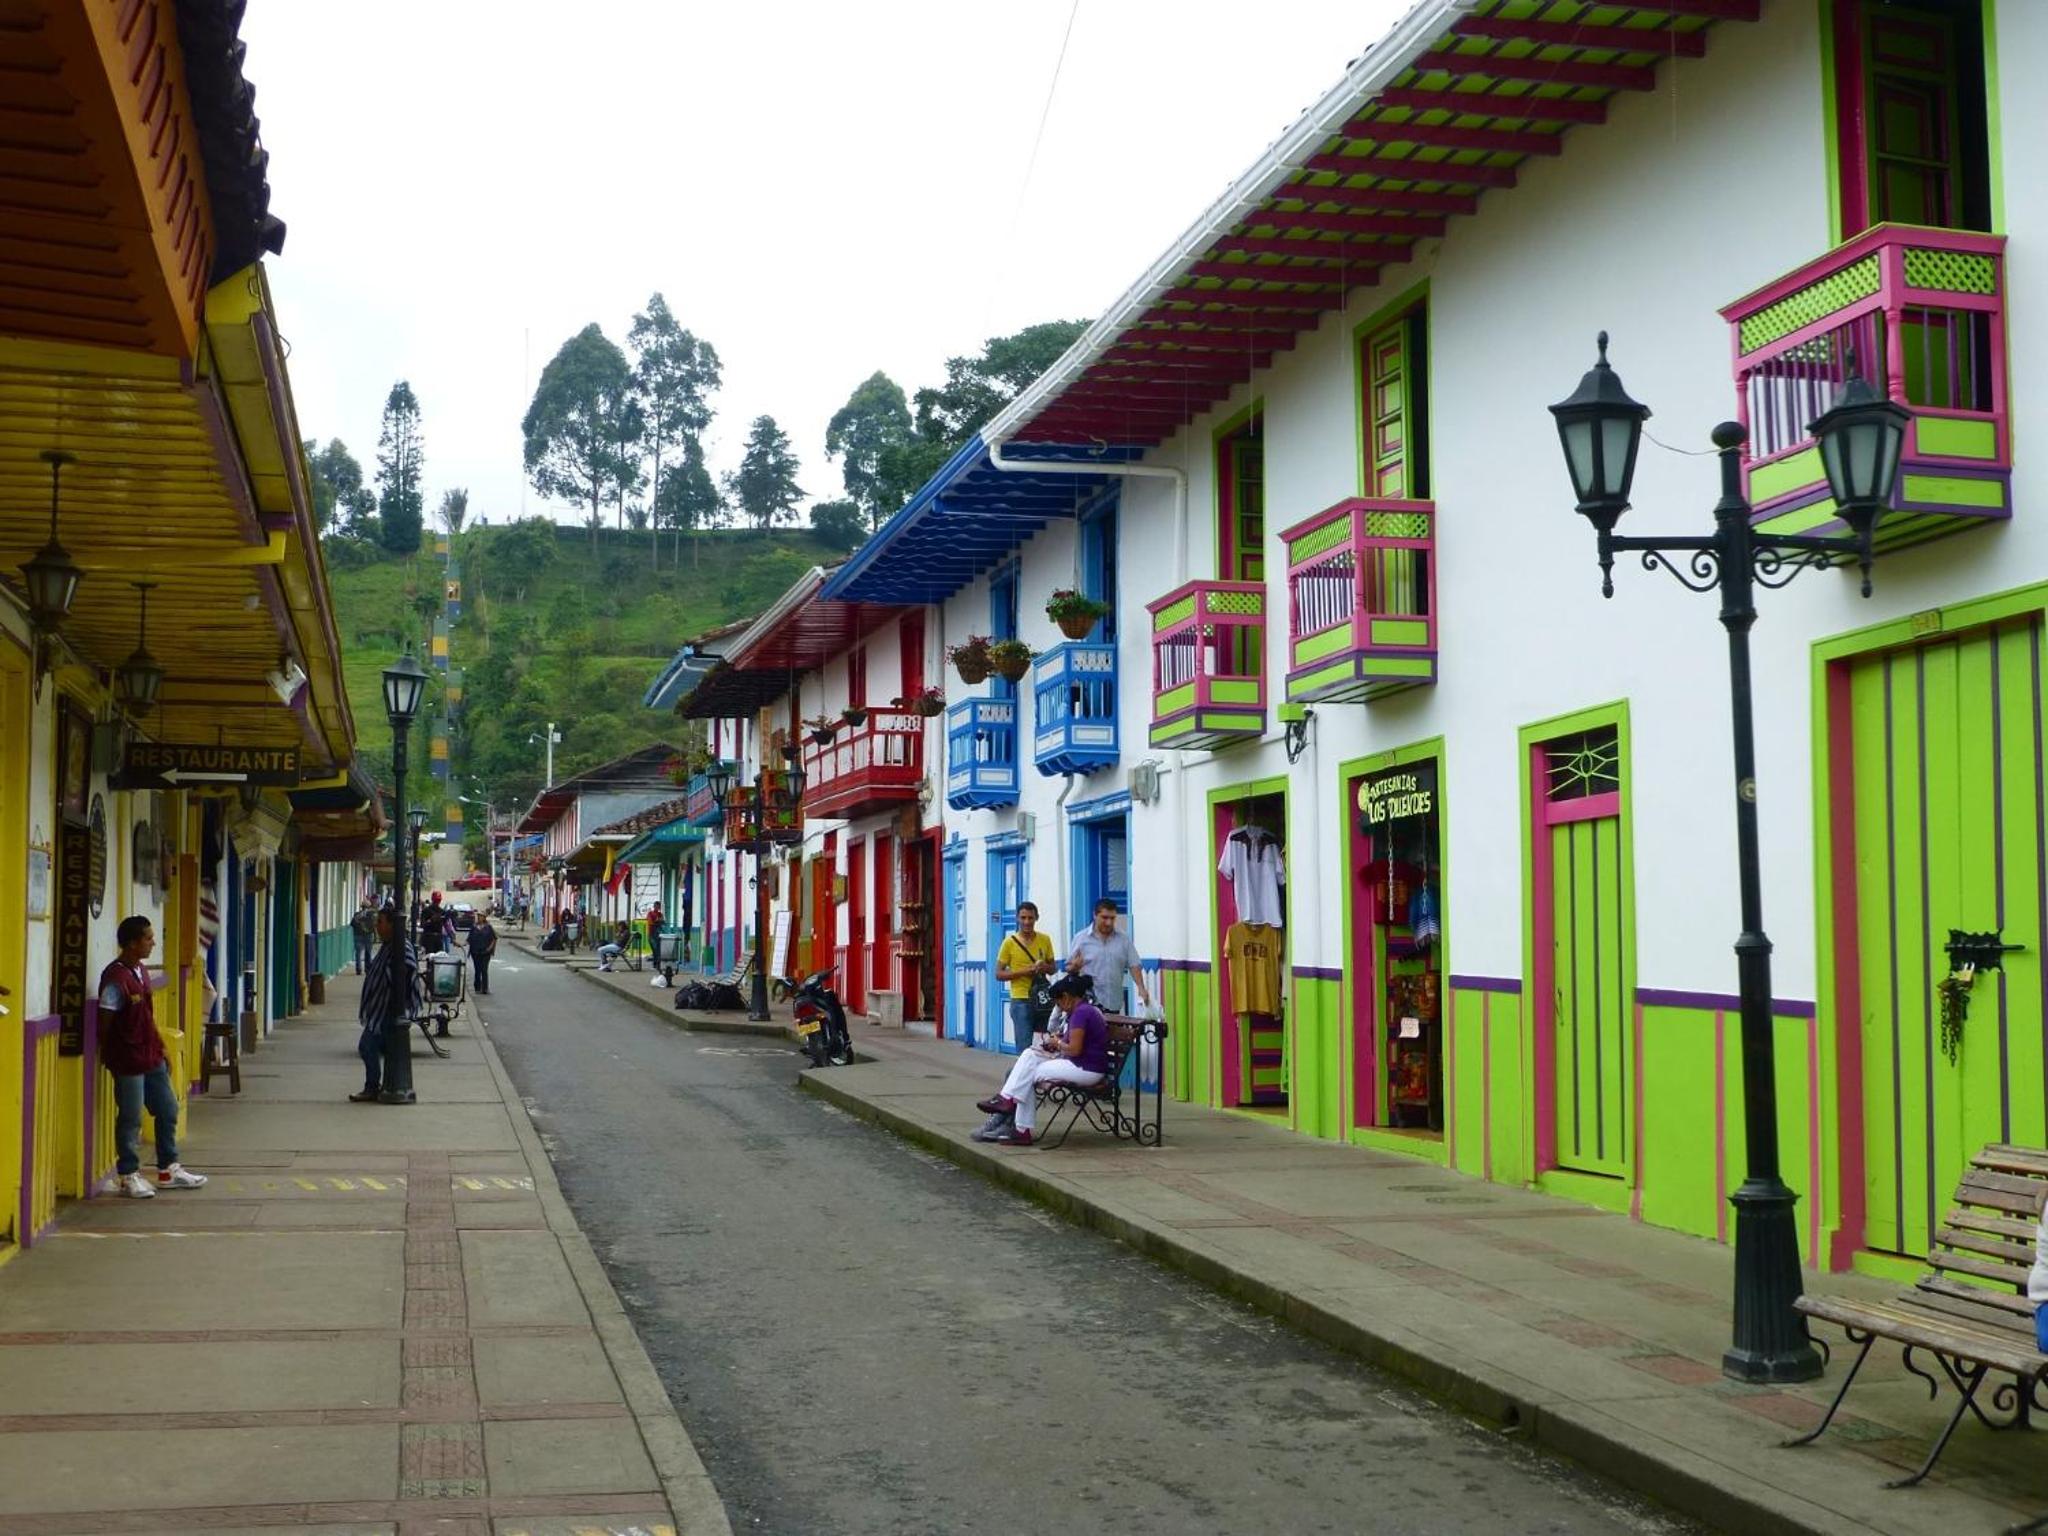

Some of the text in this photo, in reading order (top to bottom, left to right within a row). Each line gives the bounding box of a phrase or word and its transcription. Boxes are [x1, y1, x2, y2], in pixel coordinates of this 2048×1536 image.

[131, 747, 296, 771] RESTAURANTE
[1367, 790, 1432, 824] LOS DUENDES
[62, 833, 86, 1049] RESTAURANTE
